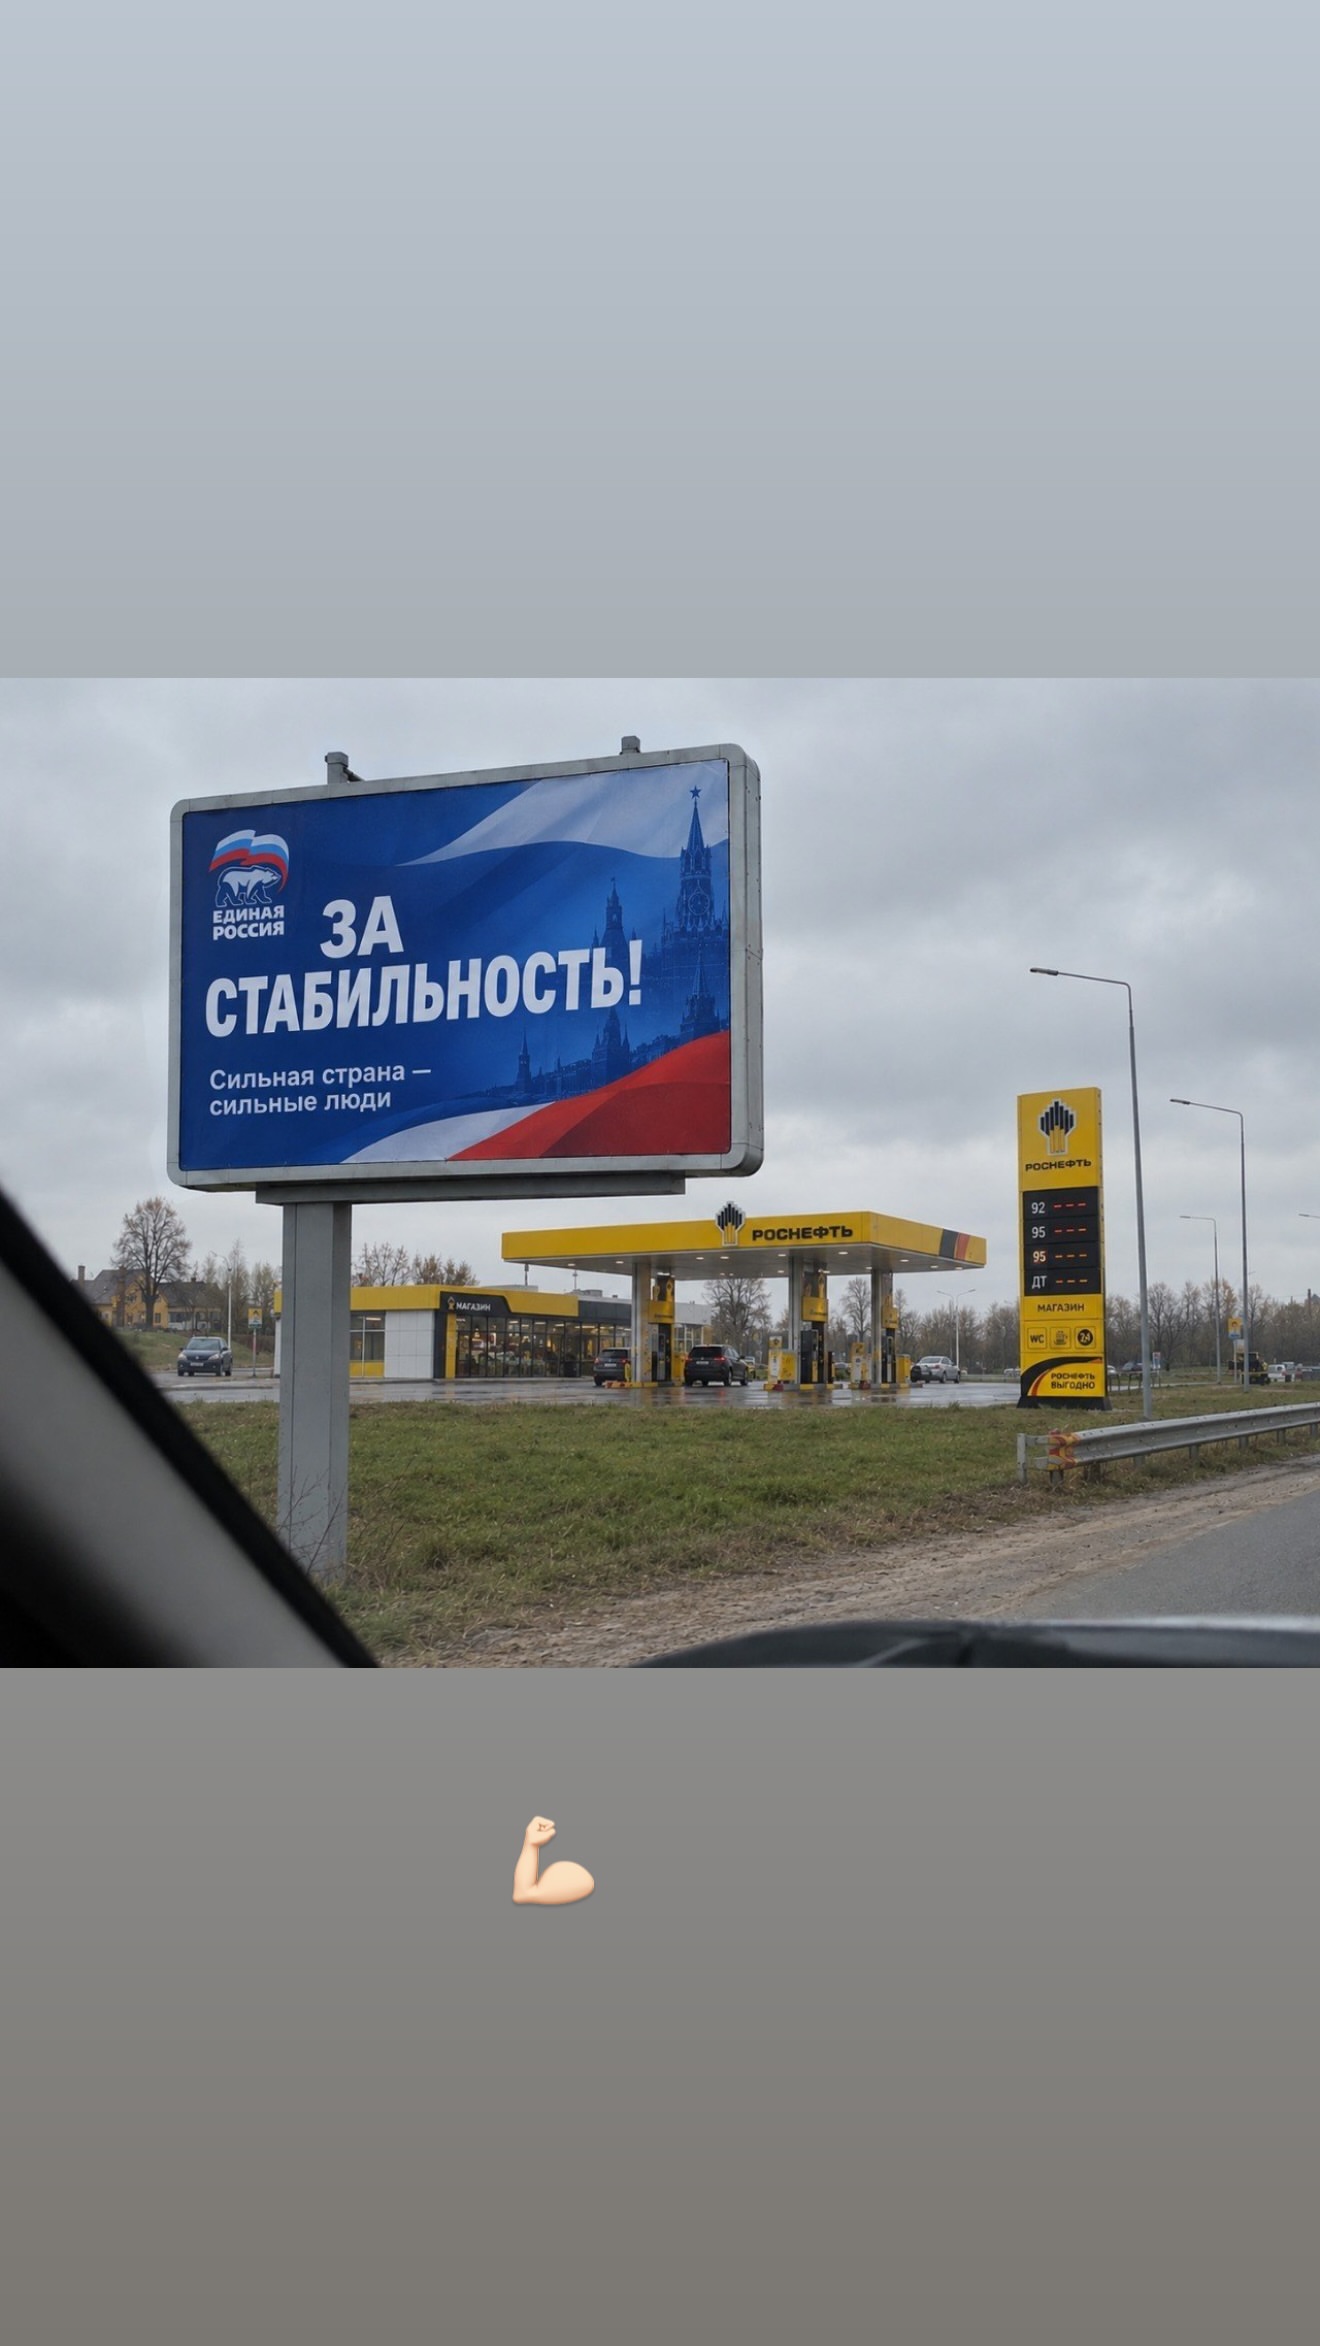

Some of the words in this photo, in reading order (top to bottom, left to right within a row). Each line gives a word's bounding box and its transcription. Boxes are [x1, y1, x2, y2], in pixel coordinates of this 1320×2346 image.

[212, 904, 285, 925] ЕДИНАЯ
[212, 920, 285, 941] РОССИЯ
[319, 895, 405, 959] ЗА
[205, 939, 643, 1038] СТАБИЛЬНОСТЬ!
[209, 1069, 315, 1090] Сильная
[321, 1065, 405, 1088] страна
[209, 1095, 318, 1116] сильные
[324, 1092, 392, 1113] люди
[1025, 1158, 1092, 1172] РОСНЕФТЬ
[1031, 1201, 1046, 1214] 92
[752, 1225, 853, 1241] РОСНЕФТЬ
[1031, 1226, 1046, 1239] 95
[1032, 1250, 1047, 1263] 95
[1031, 1275, 1047, 1289] ДТ
[456, 1301, 491, 1312] МАГАЗИН
[1037, 1303, 1085, 1313] МАГАЗИН
[1029, 1333, 1045, 1344] WC
[1050, 1381, 1096, 1390] ВЫГОДНО
